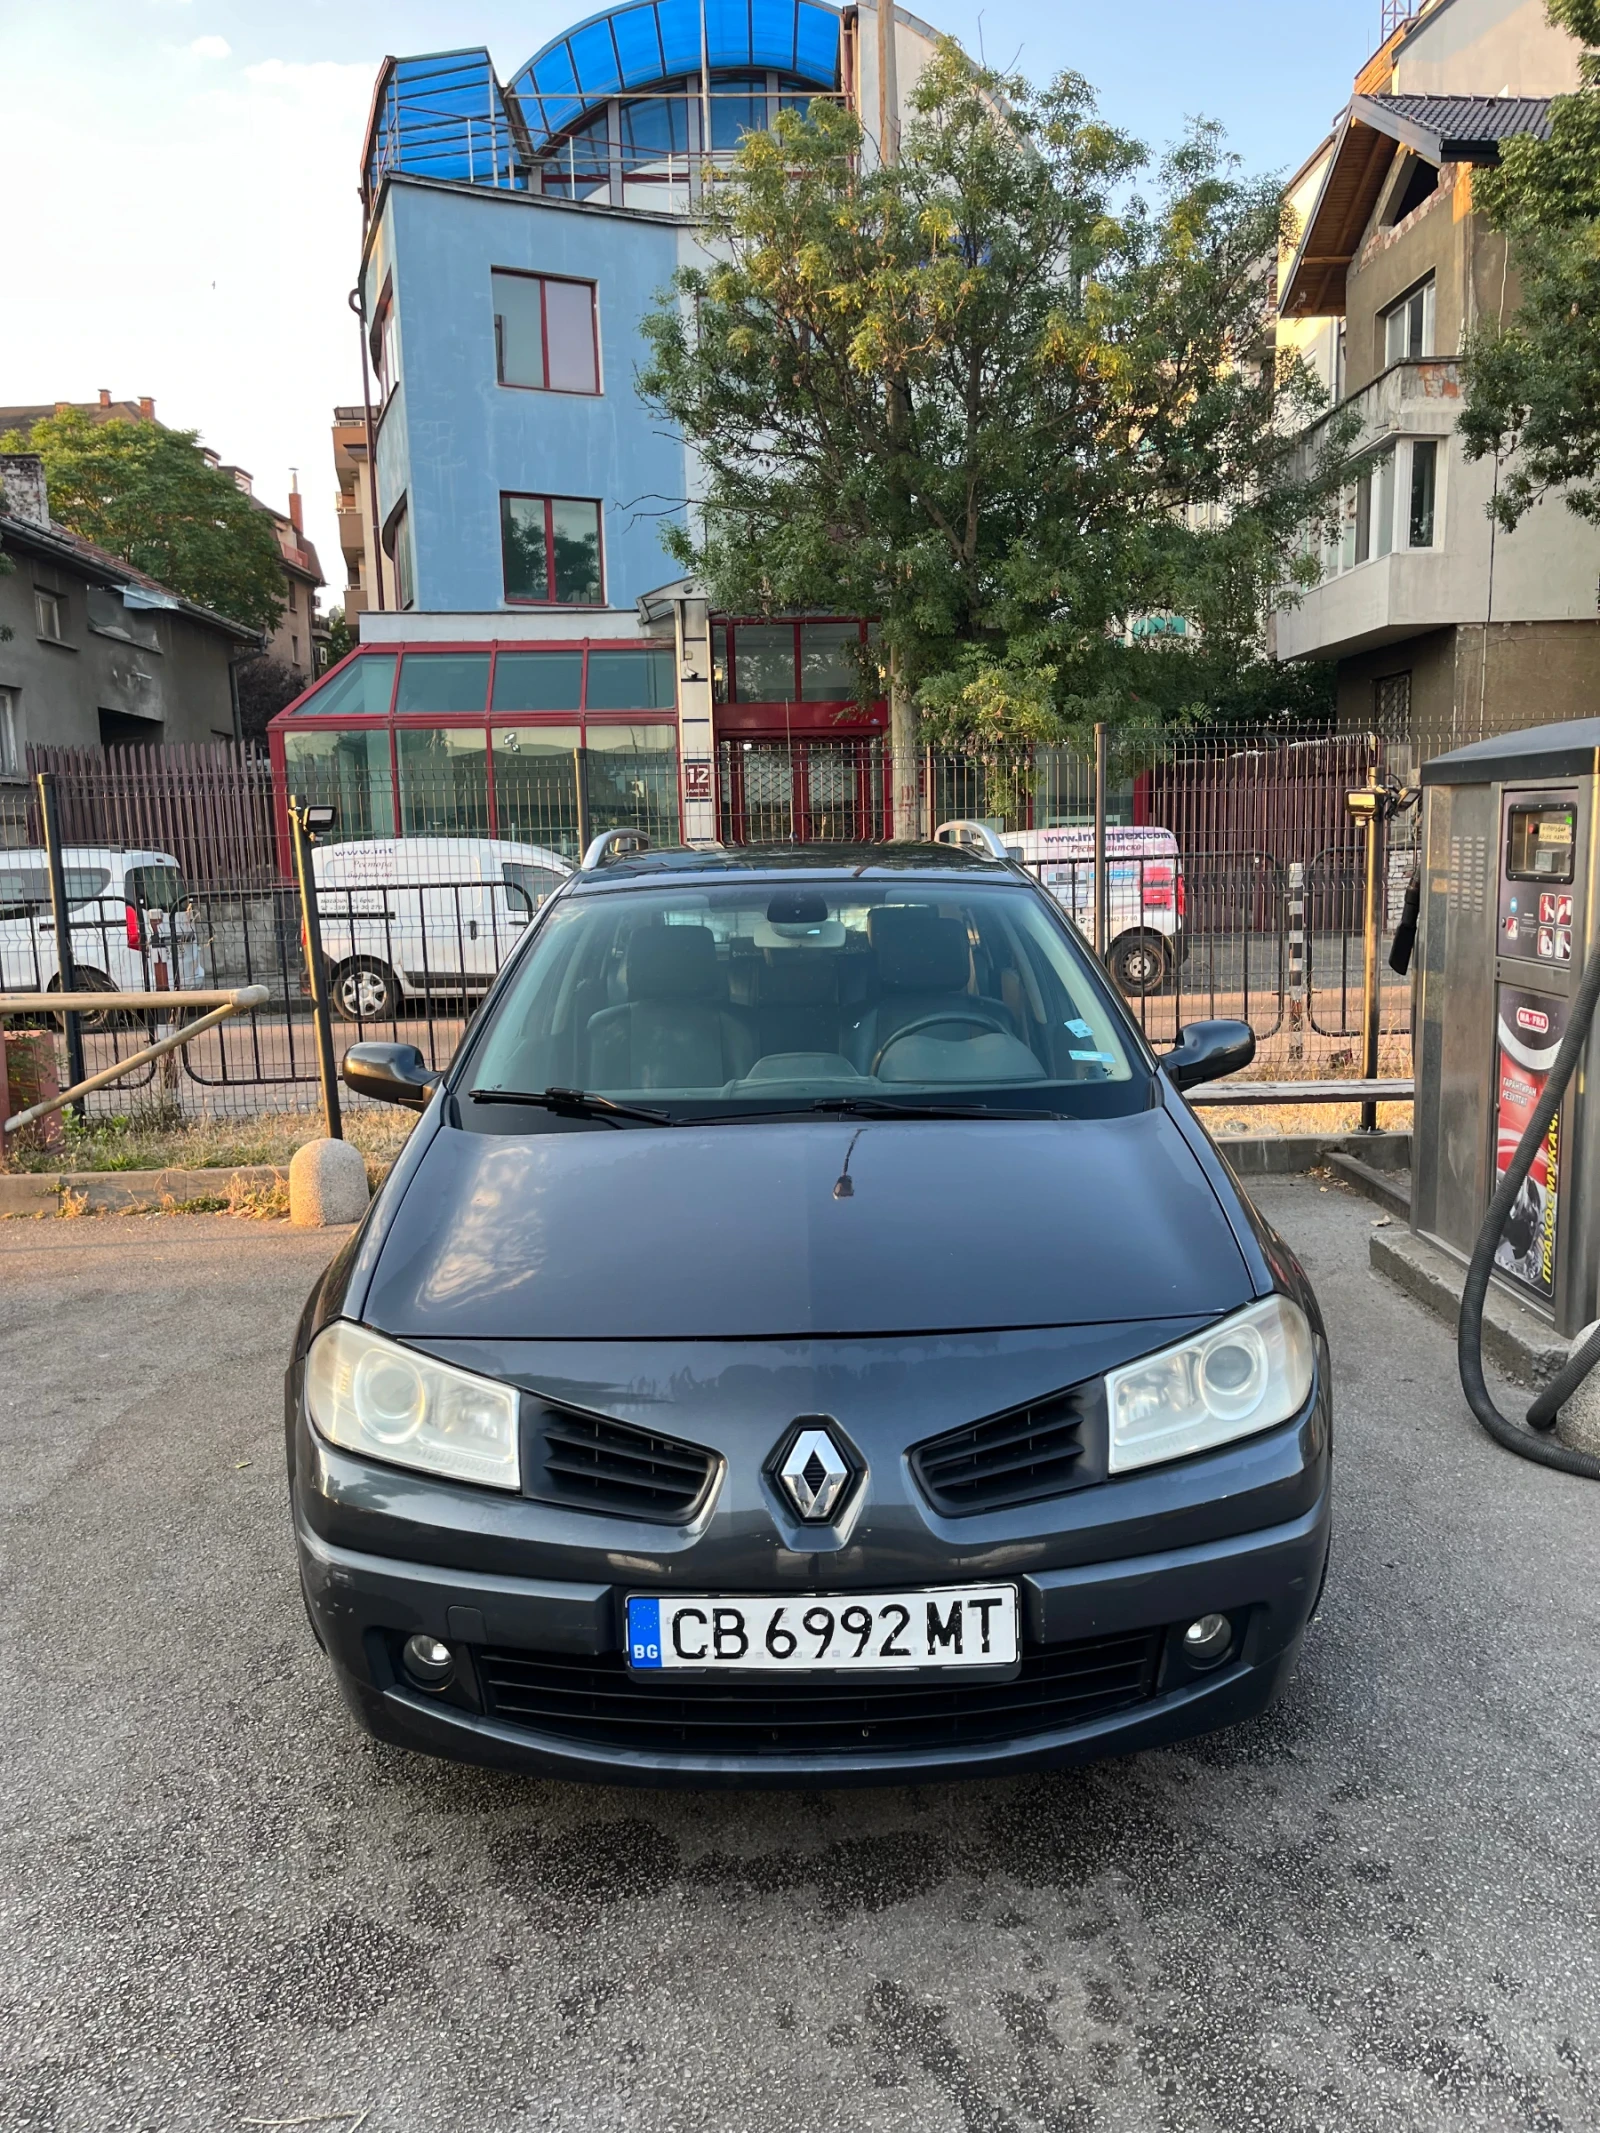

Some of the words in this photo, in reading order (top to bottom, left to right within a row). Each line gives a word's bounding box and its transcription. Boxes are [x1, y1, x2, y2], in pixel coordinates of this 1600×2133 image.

[688, 768, 709, 783] 12
[1044, 832, 1171, 843] www.intmpex.com
[1070, 844, 1142, 853] Рестантско
[1503, 1077, 1537, 1097] ГАРАНТИРАН
[1503, 1089, 1528, 1107] РЕЗУЛТАТ
[1542, 1111, 1559, 1284] ПРАХОСМУКАЧ
[671, 1607, 749, 1660] CB
[765, 1604, 912, 1660] 6992
[926, 1597, 1002, 1656] MT
[633, 1645, 658, 1660] BG
